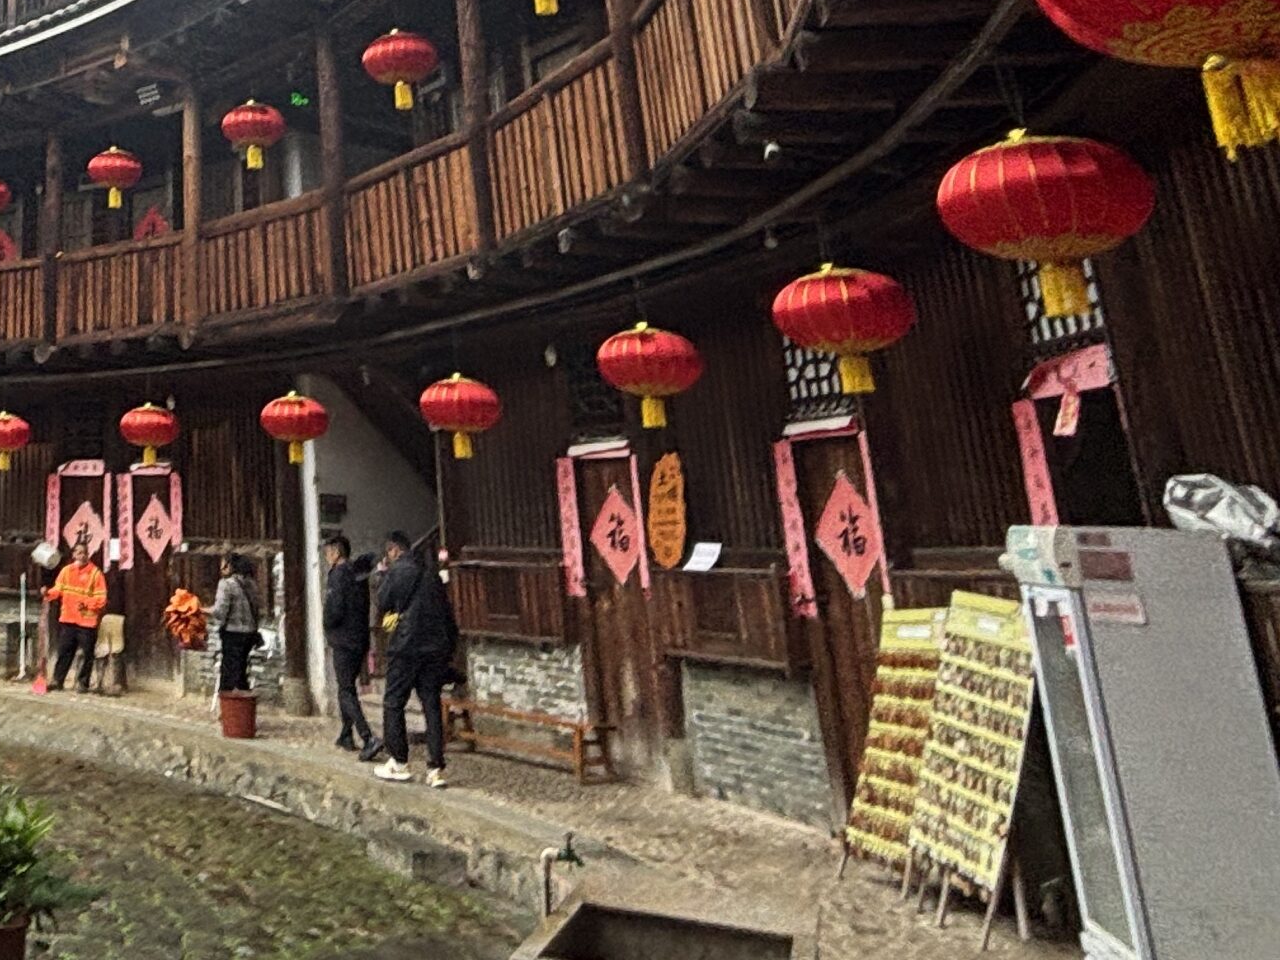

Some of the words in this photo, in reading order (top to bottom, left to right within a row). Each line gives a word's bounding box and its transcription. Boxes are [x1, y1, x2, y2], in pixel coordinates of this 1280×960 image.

[144, 515, 163, 539] 福
[606, 512, 631, 553] 福
[837, 504, 866, 557] 福
